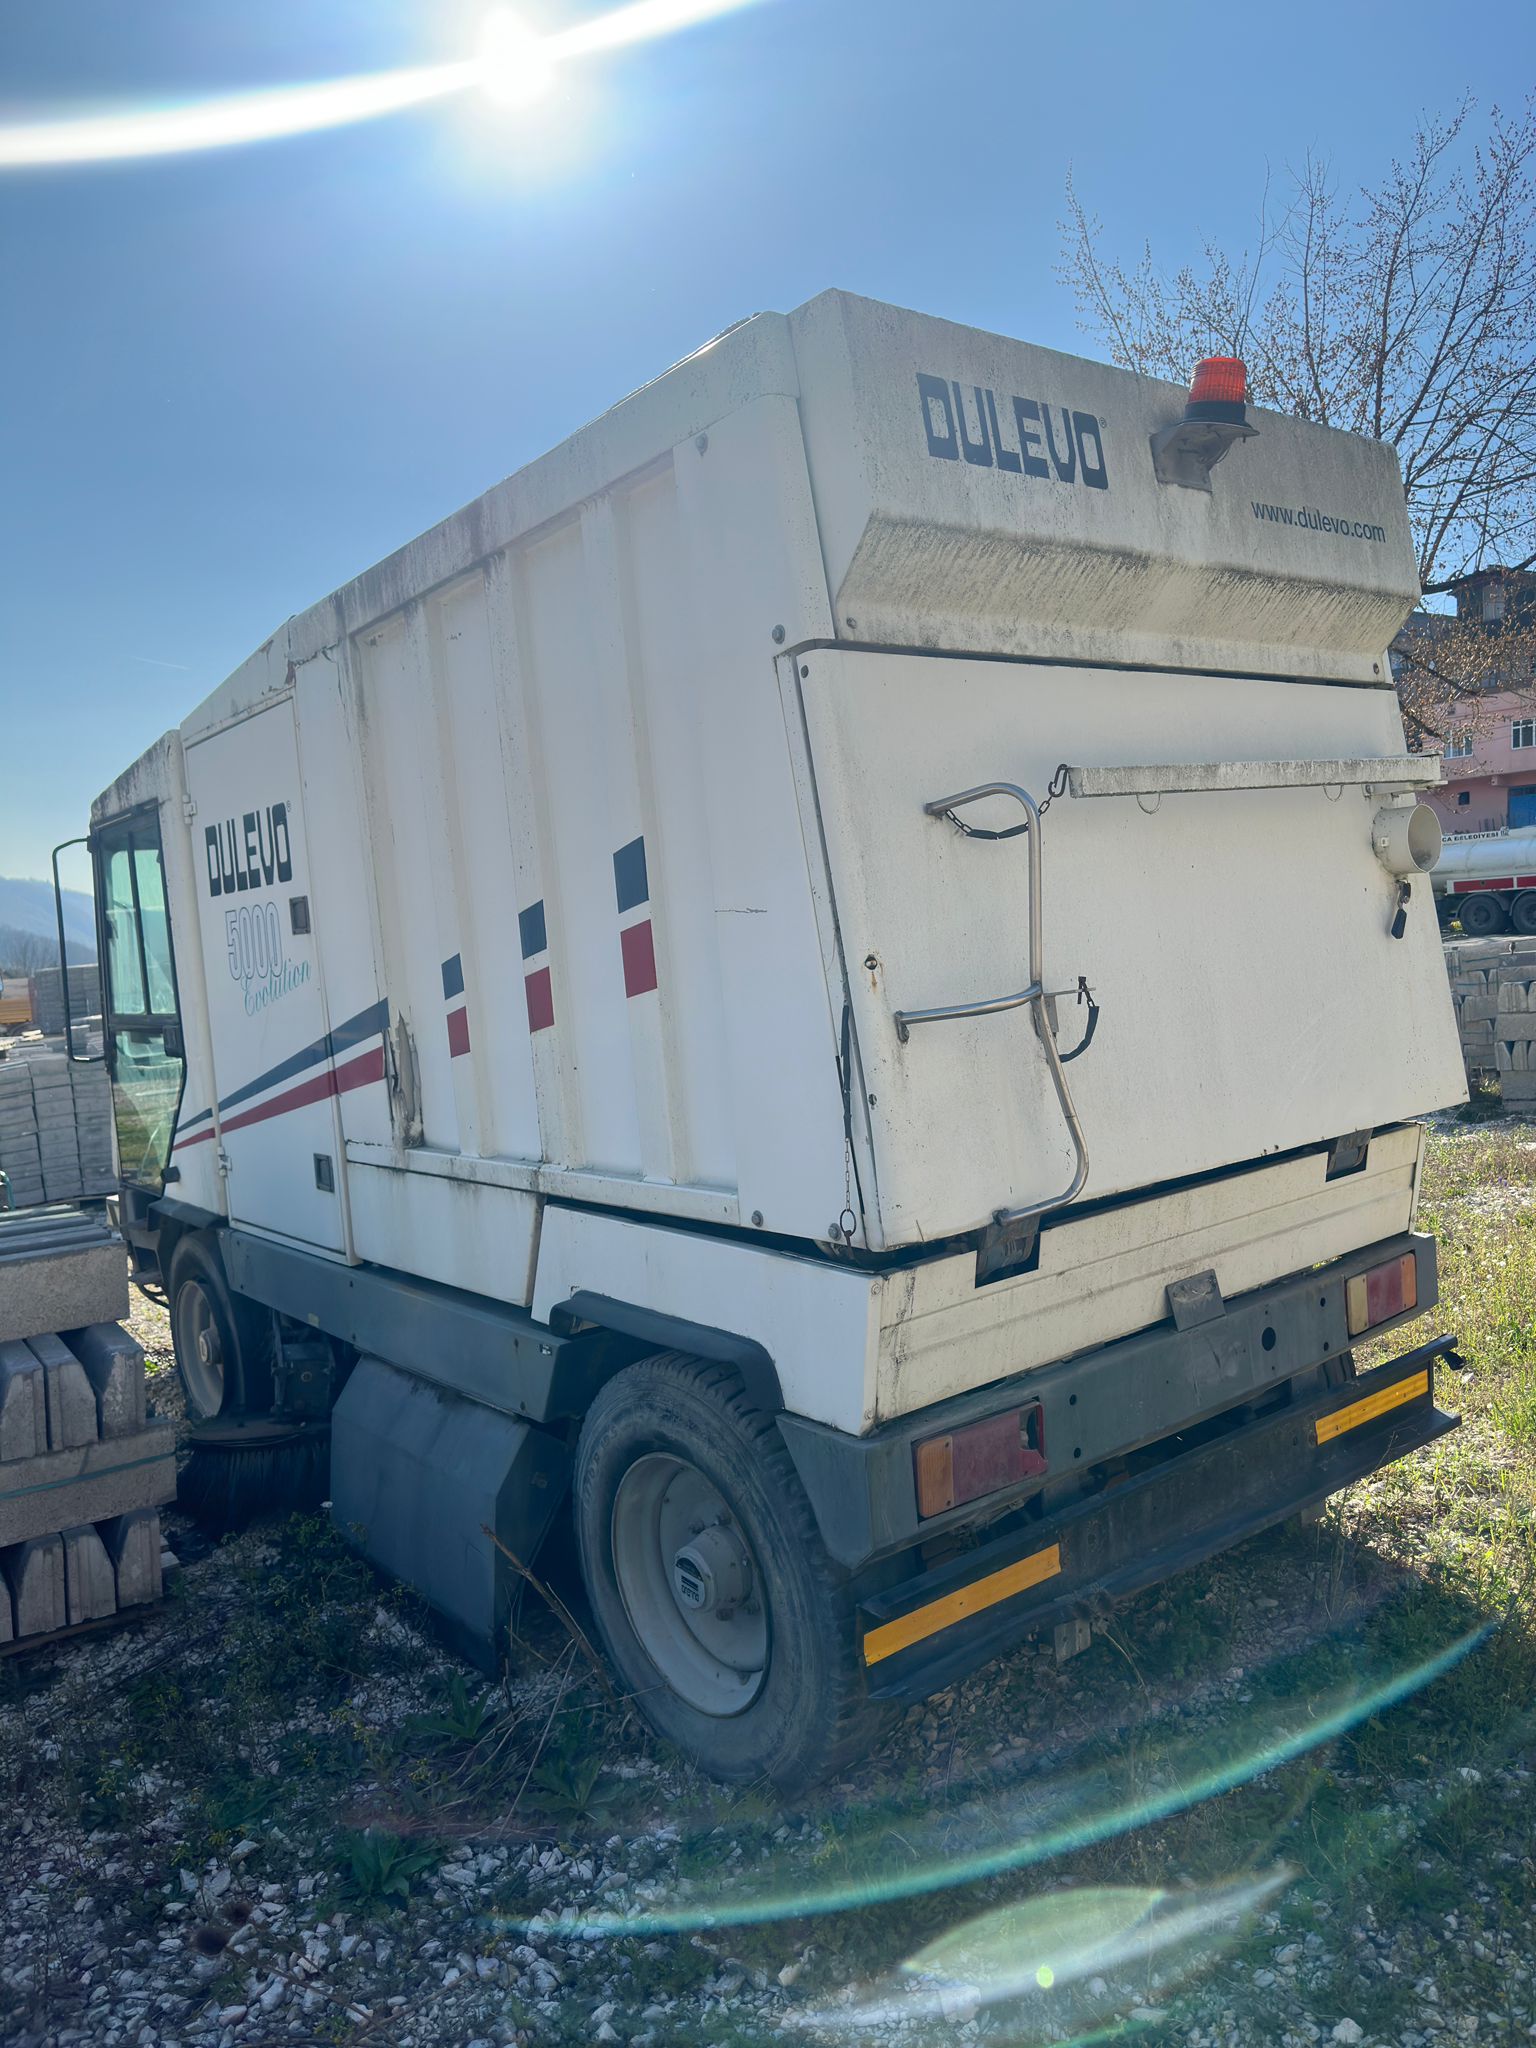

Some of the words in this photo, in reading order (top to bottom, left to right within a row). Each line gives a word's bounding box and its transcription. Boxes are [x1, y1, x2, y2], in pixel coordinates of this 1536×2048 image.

[1251, 501, 1385, 543] www.dulevo.com
[225, 901, 283, 981] 5000
[241, 958, 310, 1016] Evolution
